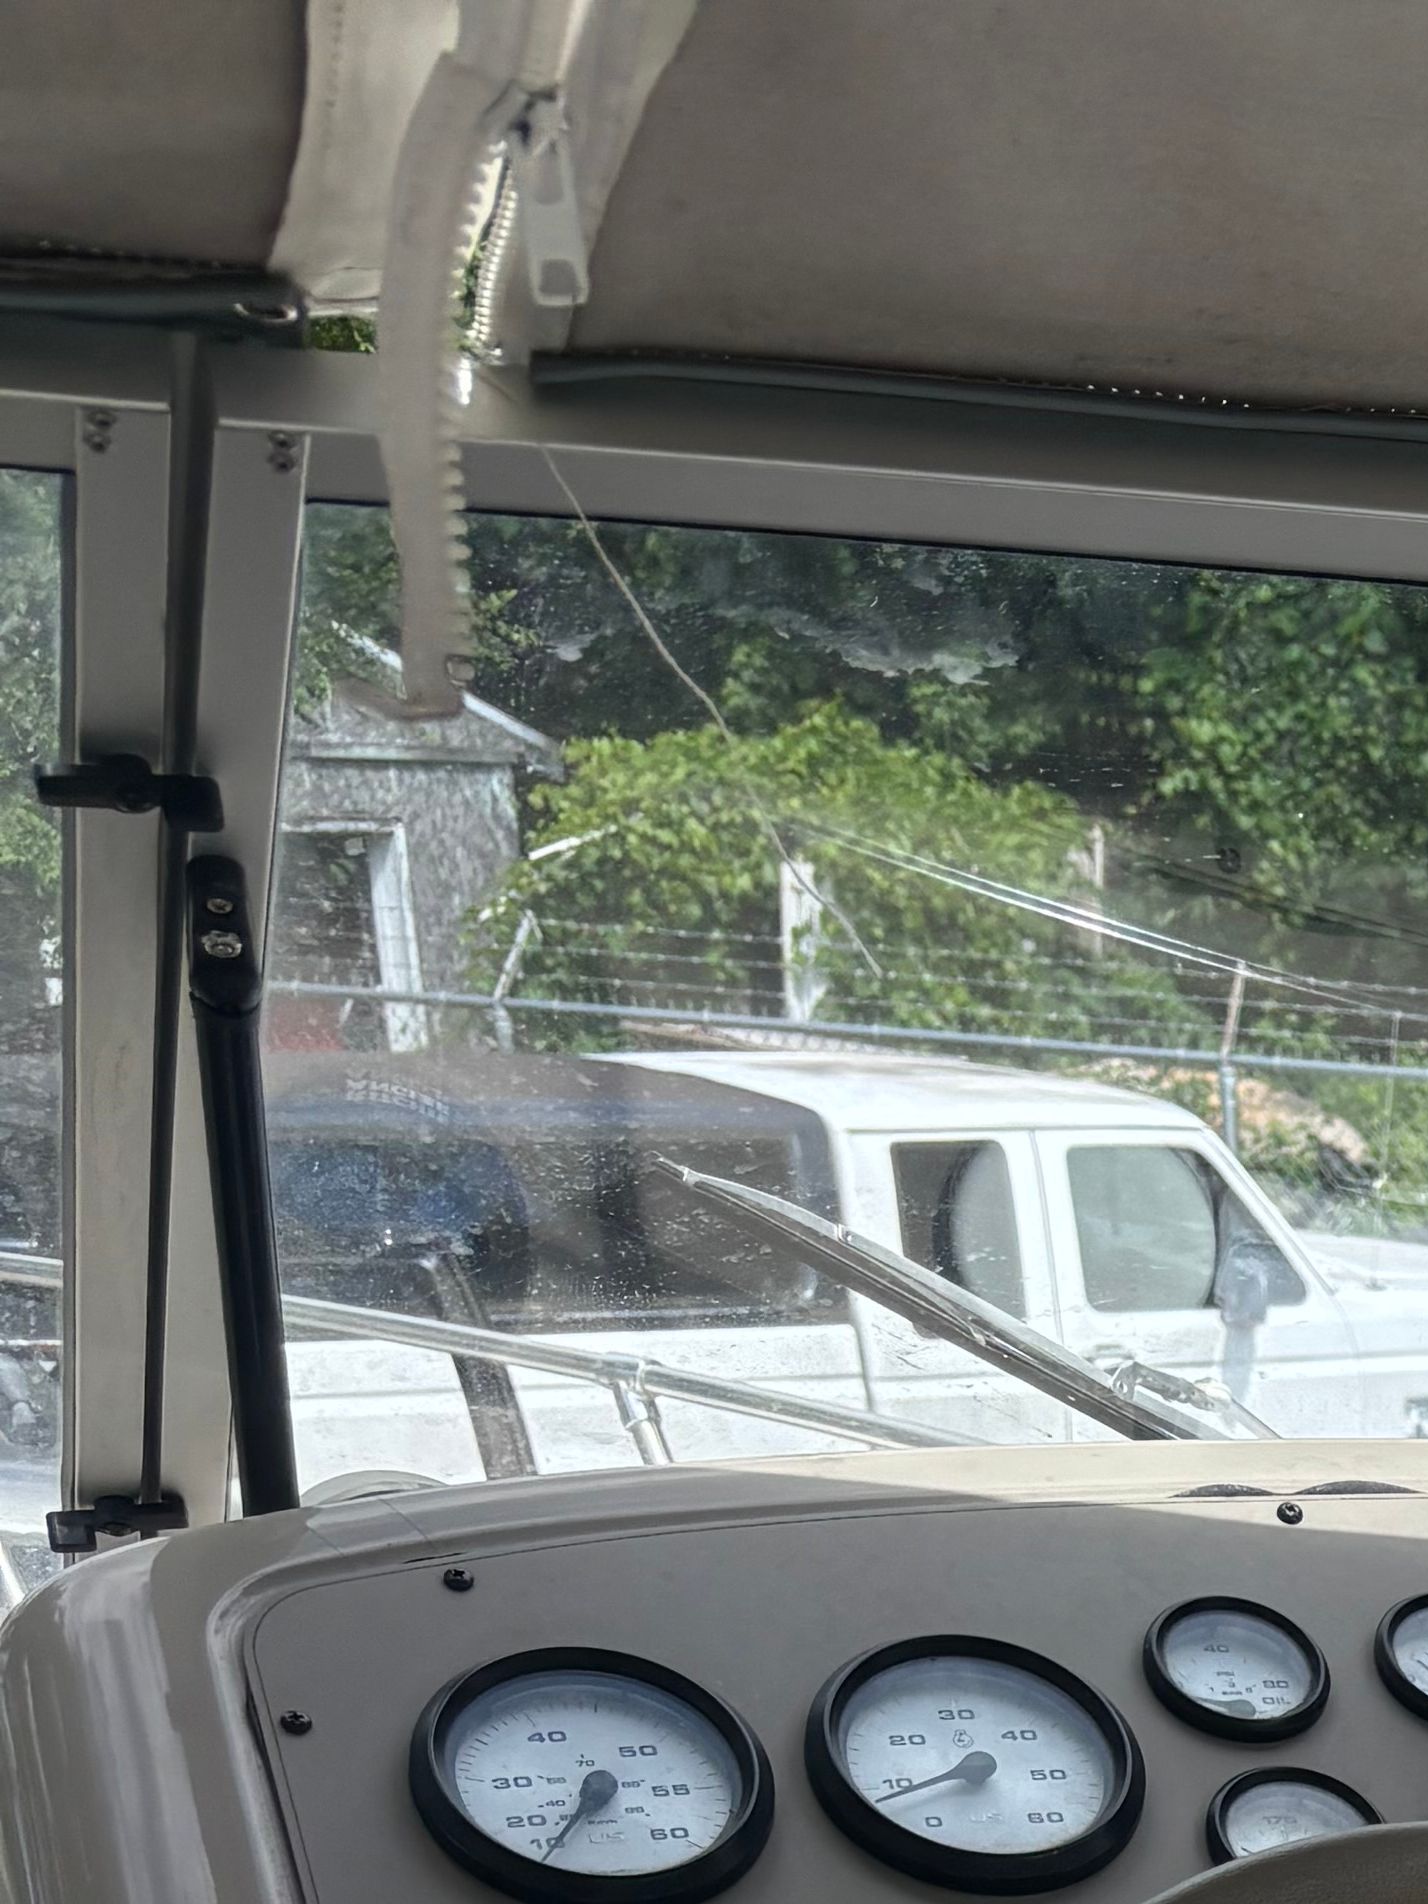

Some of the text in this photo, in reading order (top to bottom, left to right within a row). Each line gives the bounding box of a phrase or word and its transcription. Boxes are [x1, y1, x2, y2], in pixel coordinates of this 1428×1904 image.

[938, 1709, 975, 1721] 30
[527, 1731, 567, 1743] 40
[888, 1734, 926, 1746] 20
[1001, 1730, 1038, 1741] 40
[618, 1744, 658, 1758] 50
[1030, 1769, 1067, 1781] 50
[492, 1776, 533, 1790] 30
[651, 1784, 690, 1797] 55
[506, 1814, 547, 1828] 20
[650, 1827, 689, 1841] 60
